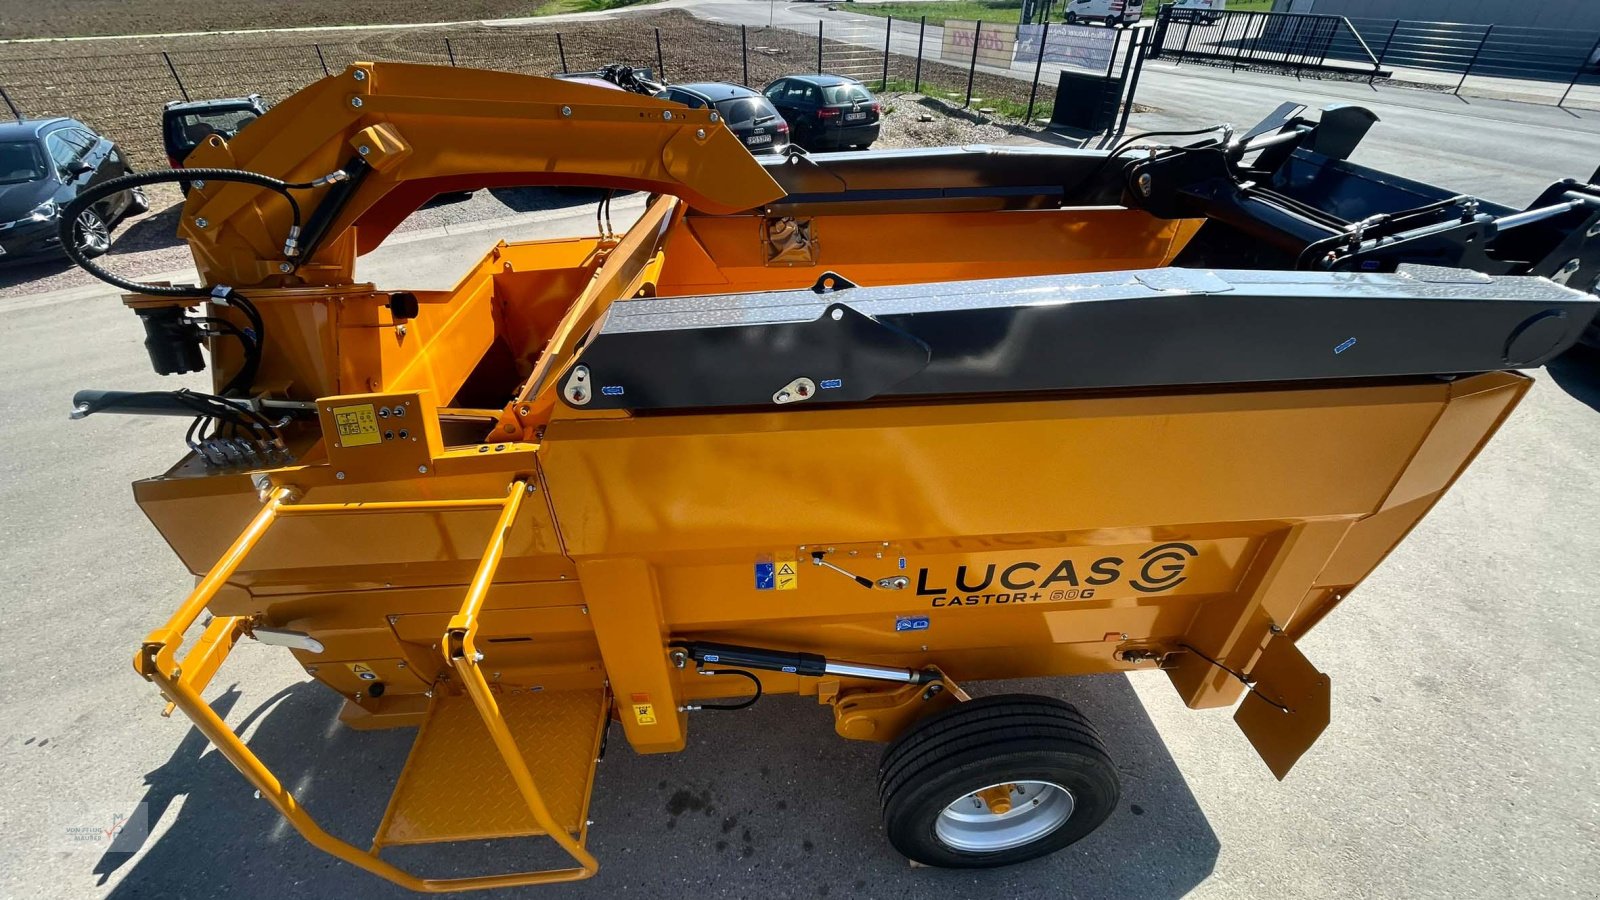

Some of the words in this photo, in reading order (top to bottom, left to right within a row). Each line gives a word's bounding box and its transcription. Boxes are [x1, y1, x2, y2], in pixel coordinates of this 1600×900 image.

[916, 556, 1124, 595] LUCAS
[931, 593, 1042, 607] CASTOR+
[1049, 589, 1095, 602] 60G
